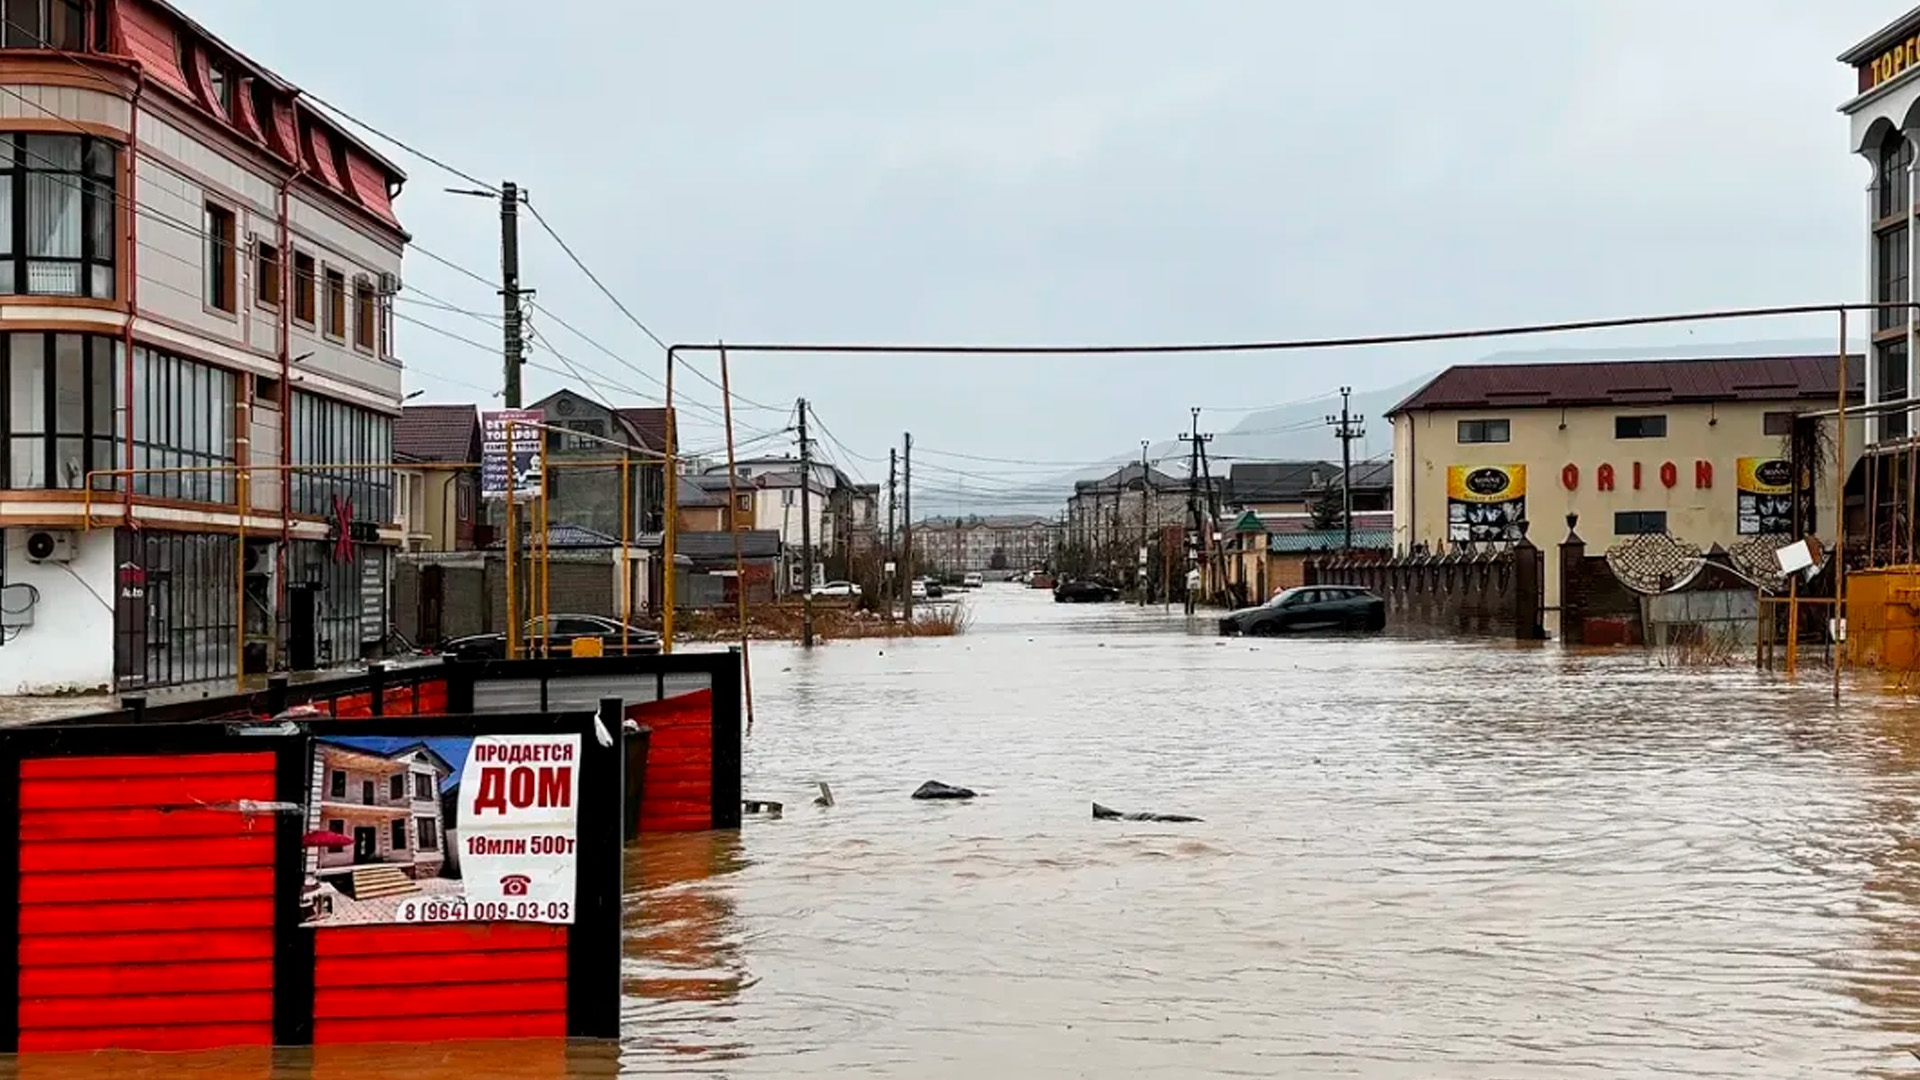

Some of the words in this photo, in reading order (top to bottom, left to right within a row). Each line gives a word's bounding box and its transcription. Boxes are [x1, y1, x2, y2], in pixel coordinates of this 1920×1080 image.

[1562, 460, 1713, 492] ORION
[475, 743, 573, 764] ПРОДАЕТСЯ
[473, 766, 572, 815] ДОМ
[467, 836, 526, 855] 18млн
[530, 835, 575, 854] 500т
[405, 903, 416, 920] 8
[420, 902, 469, 921] (964)
[474, 902, 569, 920] 009-03-03
